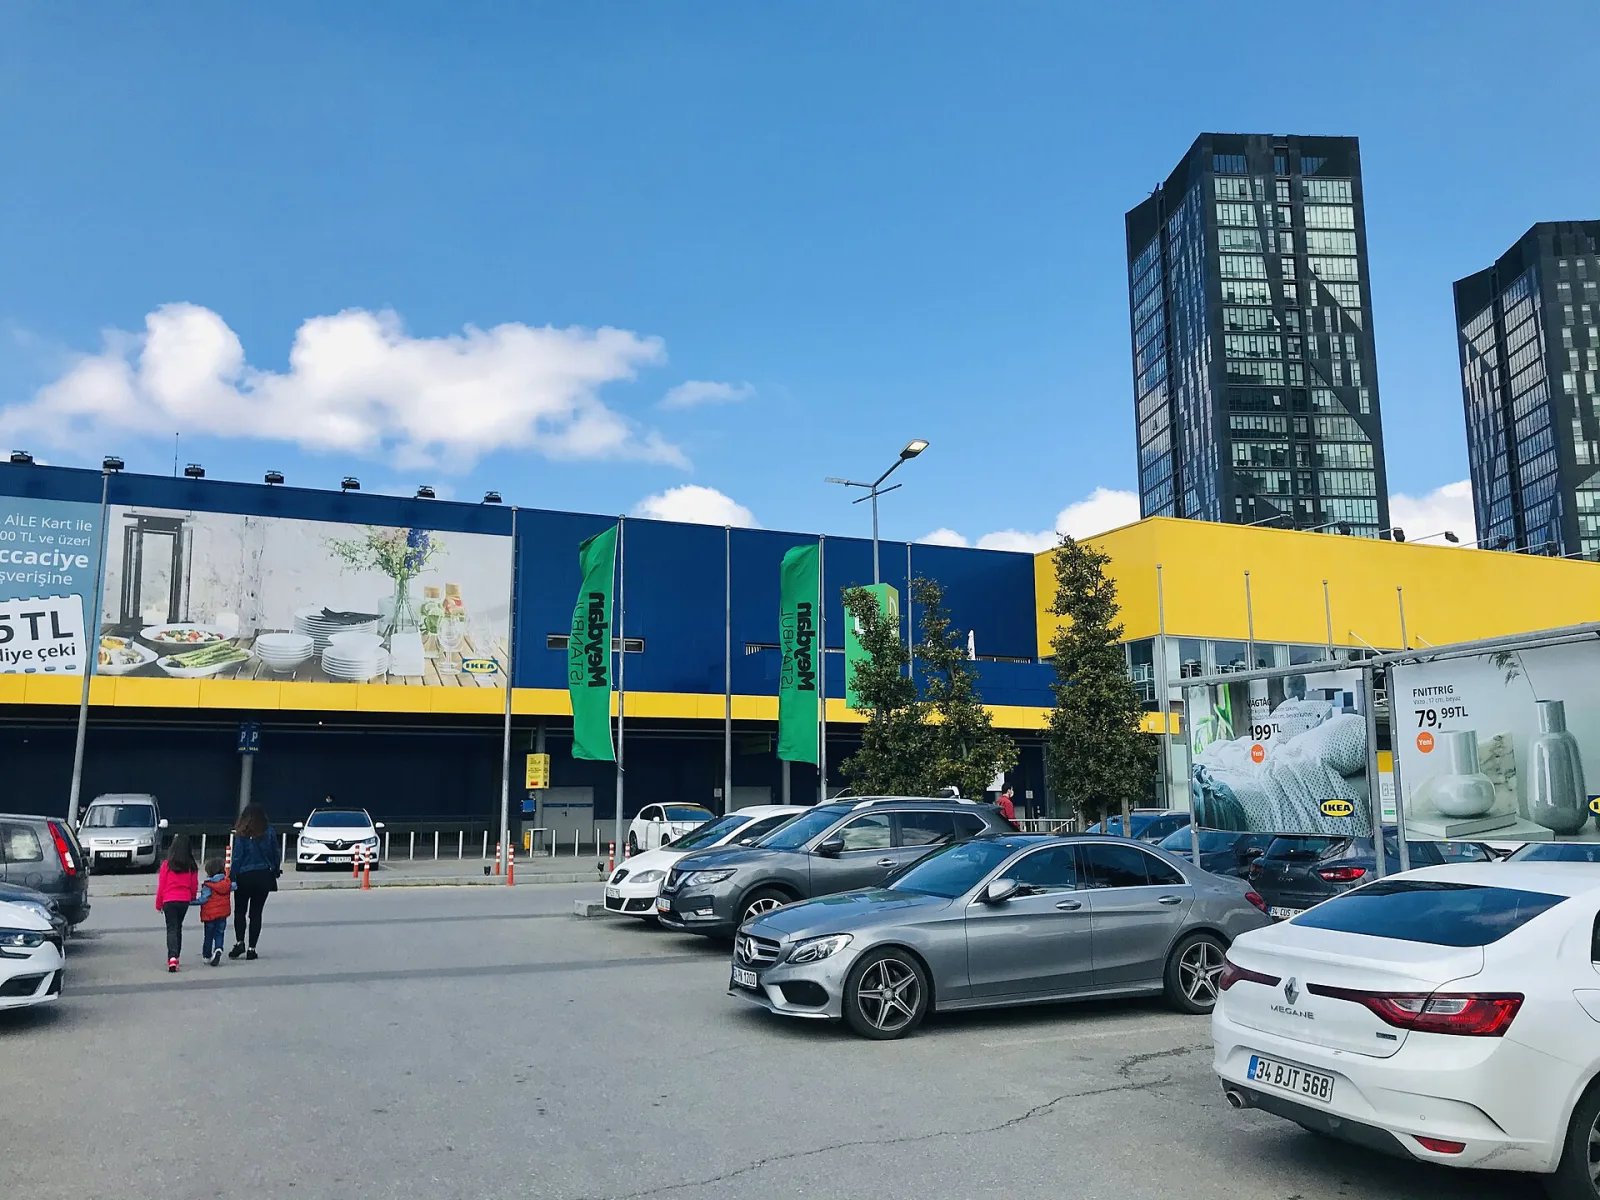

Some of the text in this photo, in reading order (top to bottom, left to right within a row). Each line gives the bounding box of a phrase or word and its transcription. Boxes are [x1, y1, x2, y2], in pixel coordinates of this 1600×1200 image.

[4, 512, 92, 532] AİLE Kart ile
[20, 531, 35, 543] TL
[39, 535, 54, 544] ve
[58, 534, 91, 547] üzeri
[0, 548, 89, 572] ccaciye
[20, 611, 74, 641] TL
[37, 642, 76, 662] çeki
[1412, 684, 1454, 697] FNITTRIG
[1418, 738, 1433, 746] Yeni
[1323, 803, 1352, 812] IKEA
[1270, 1004, 1315, 1020] MEGANE
[1256, 1061, 1271, 1082] 34
[1274, 1065, 1300, 1089] BJT
[1302, 1072, 1329, 1098] 568
